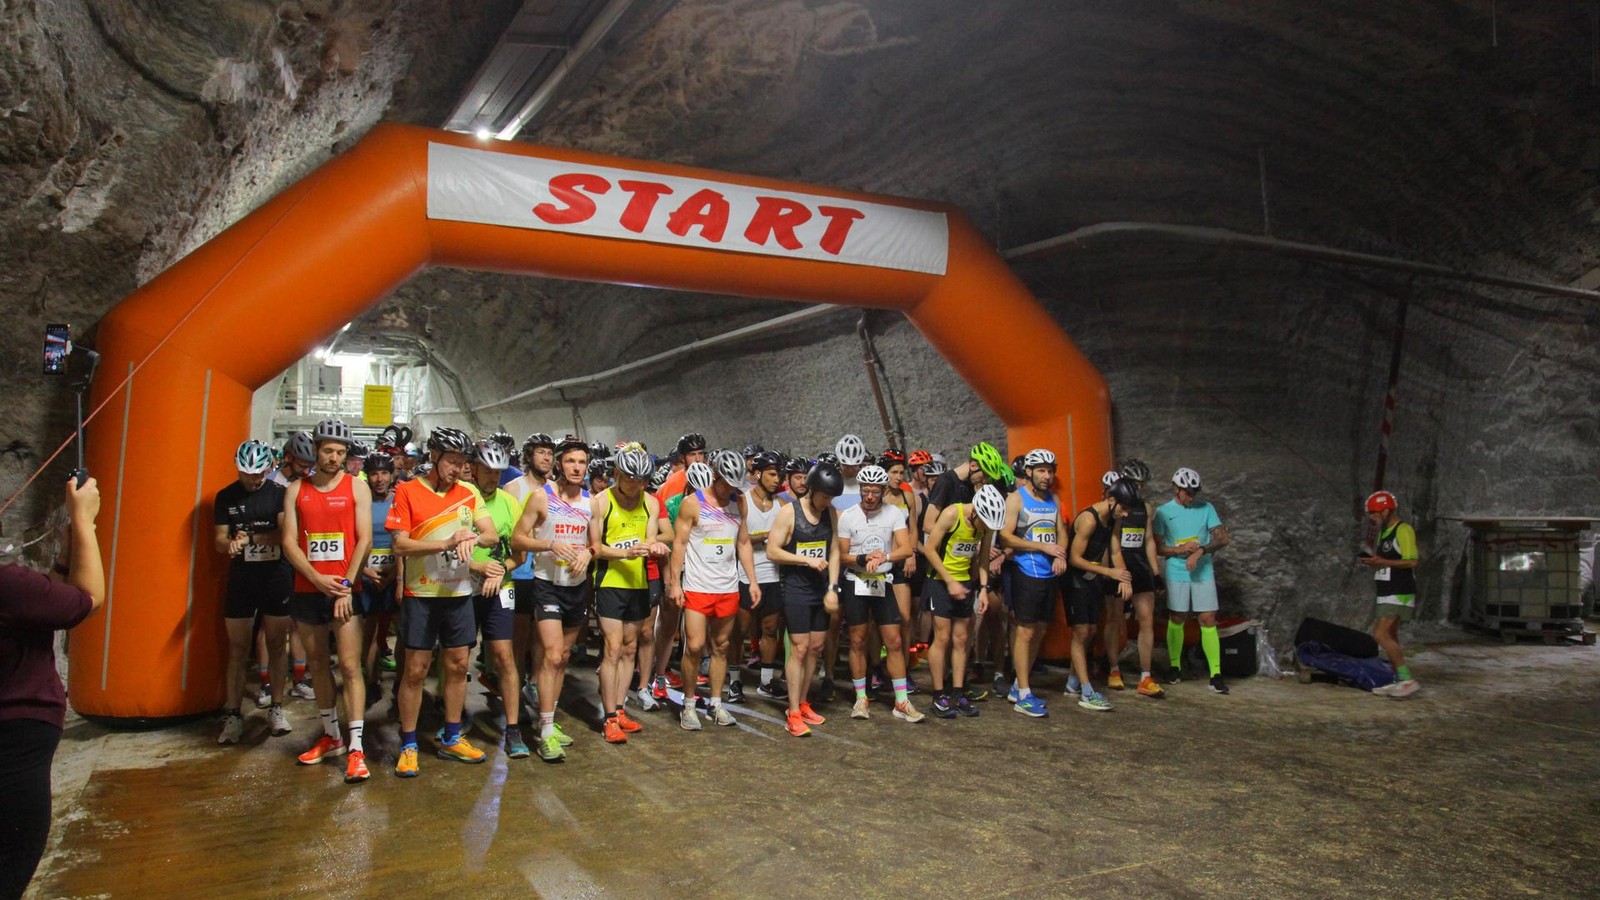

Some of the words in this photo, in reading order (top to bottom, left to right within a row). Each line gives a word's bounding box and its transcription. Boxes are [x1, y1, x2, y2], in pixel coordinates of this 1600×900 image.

[532, 172, 865, 255] START
[565, 524, 586, 535] TMP
[1037, 533, 1056, 543] 103
[1125, 533, 1143, 542] 222
[310, 540, 339, 553] 205
[715, 545, 724, 556] 3
[801, 548, 824, 558] 152
[371, 554, 396, 566] 229
[863, 578, 879, 590] 14
